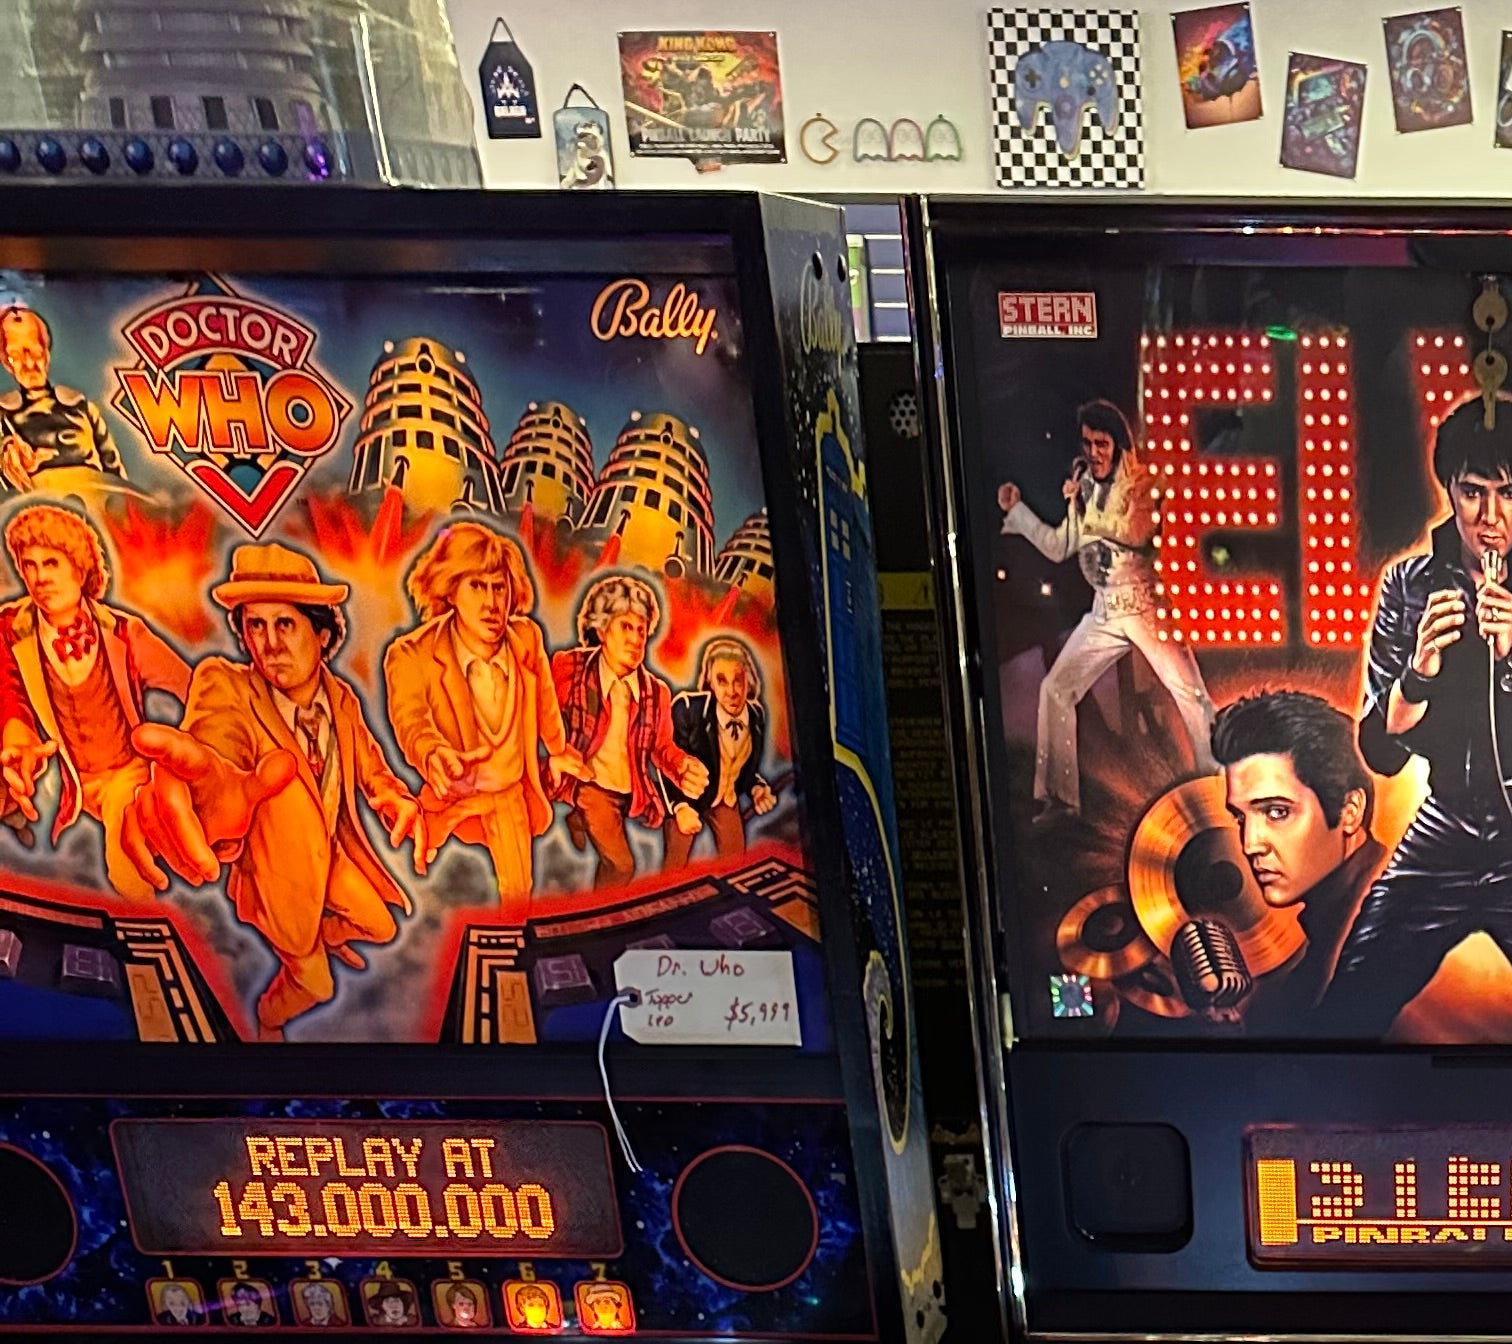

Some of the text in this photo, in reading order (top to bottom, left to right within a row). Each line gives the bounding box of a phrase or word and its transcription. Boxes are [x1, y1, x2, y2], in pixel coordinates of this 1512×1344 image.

[1002, 296, 1093, 322] STERN
[144, 306, 300, 360] DOCTOR
[125, 372, 338, 454] WHO
[657, 954, 744, 977] Dr. Who
[246, 1136, 494, 1178] REPLAY AT
[213, 1181, 555, 1239] 143.000.000
[162, 1260, 174, 1279] 1
[233, 1260, 249, 1279] 2
[307, 1261, 322, 1280] 3
[376, 1261, 393, 1279] 4
[449, 1261, 465, 1280] 5
[519, 1262, 535, 1281] 6
